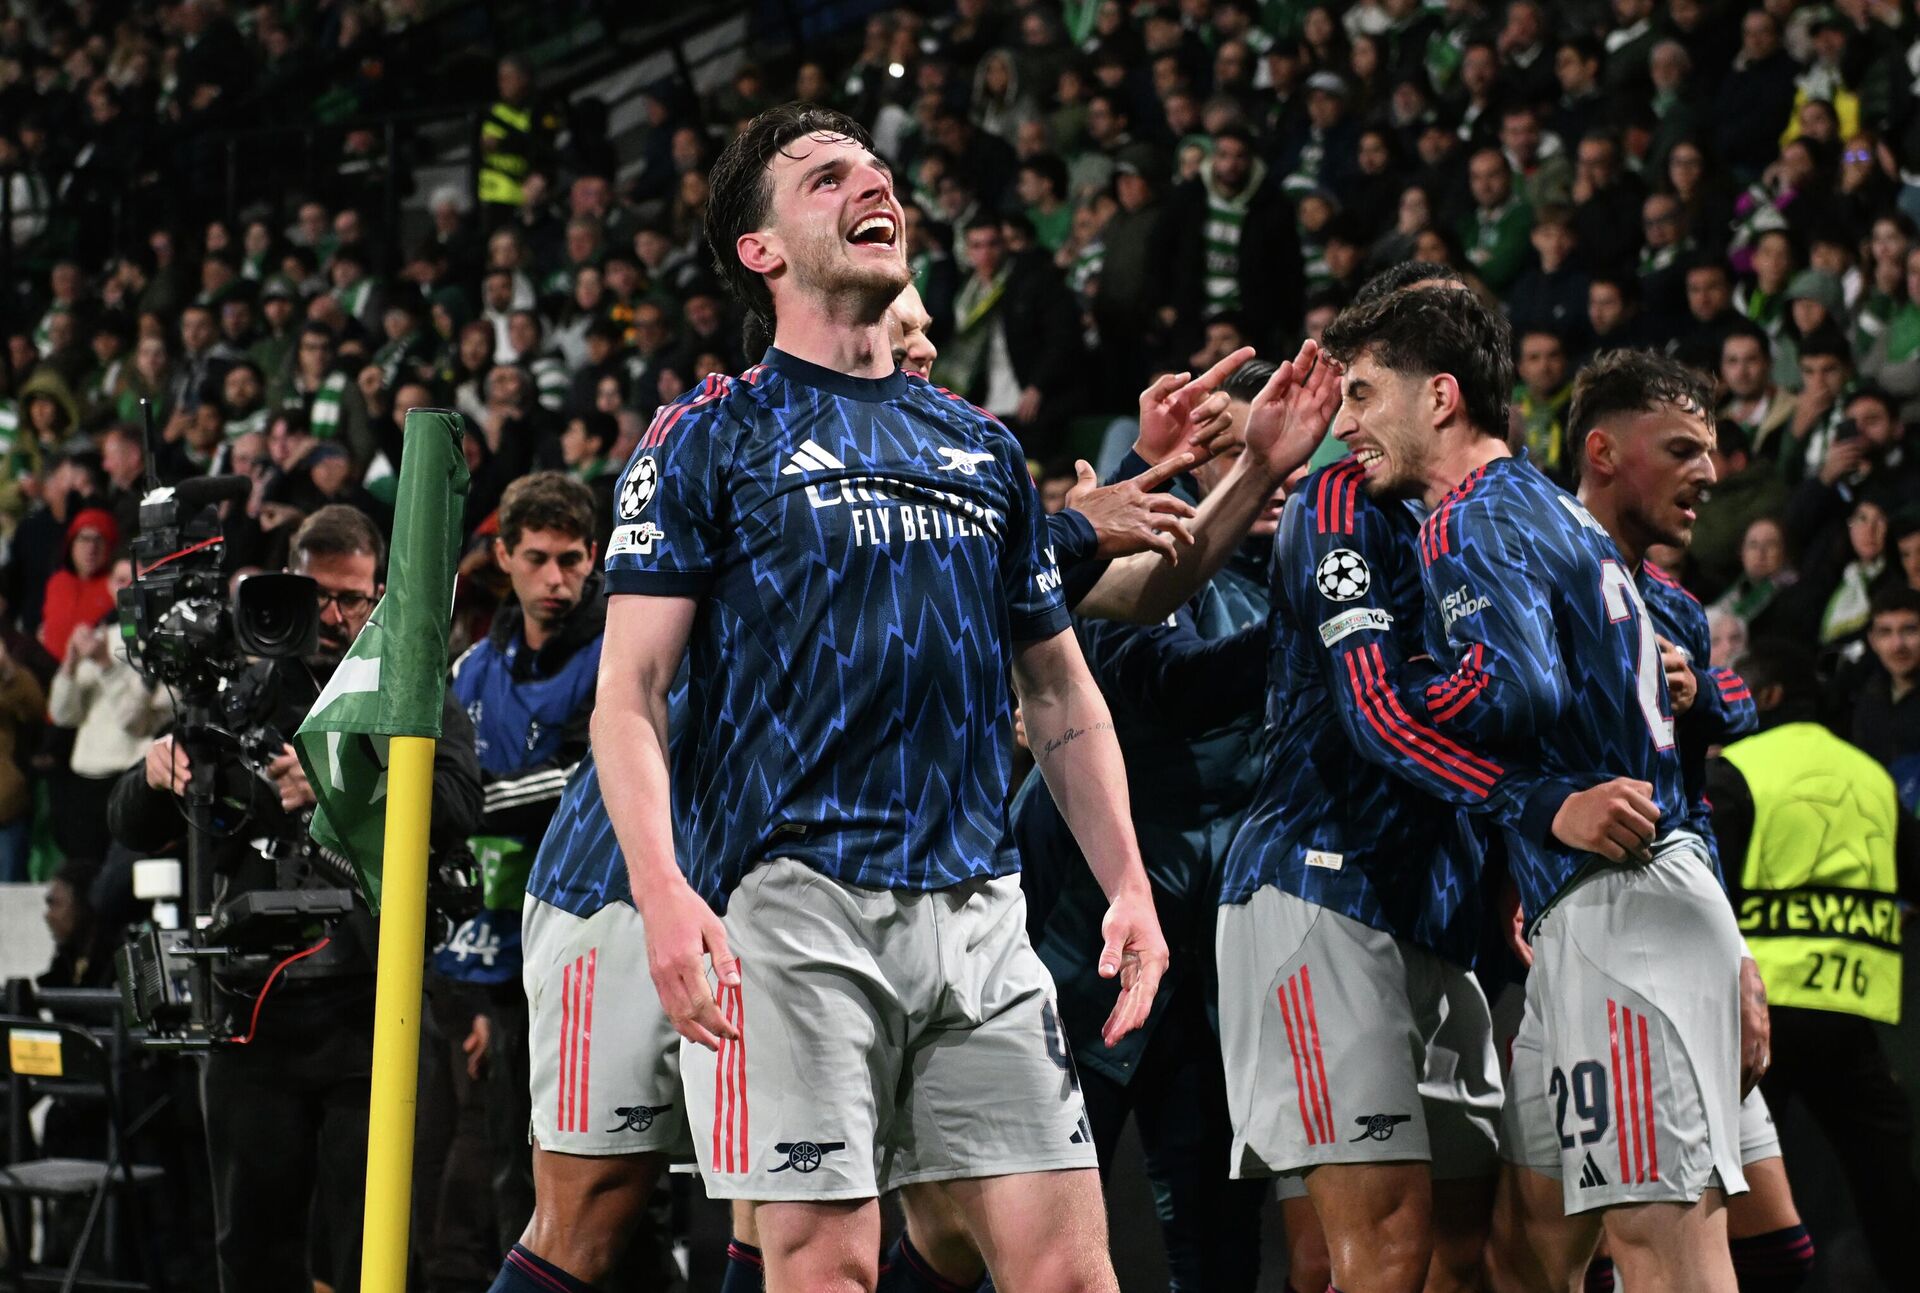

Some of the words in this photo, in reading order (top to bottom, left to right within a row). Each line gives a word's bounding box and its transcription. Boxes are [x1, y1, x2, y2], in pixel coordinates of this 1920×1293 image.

[852, 507, 890, 546] FLY
[1802, 951, 1869, 998] 276
[1548, 1060, 1609, 1150] 29
